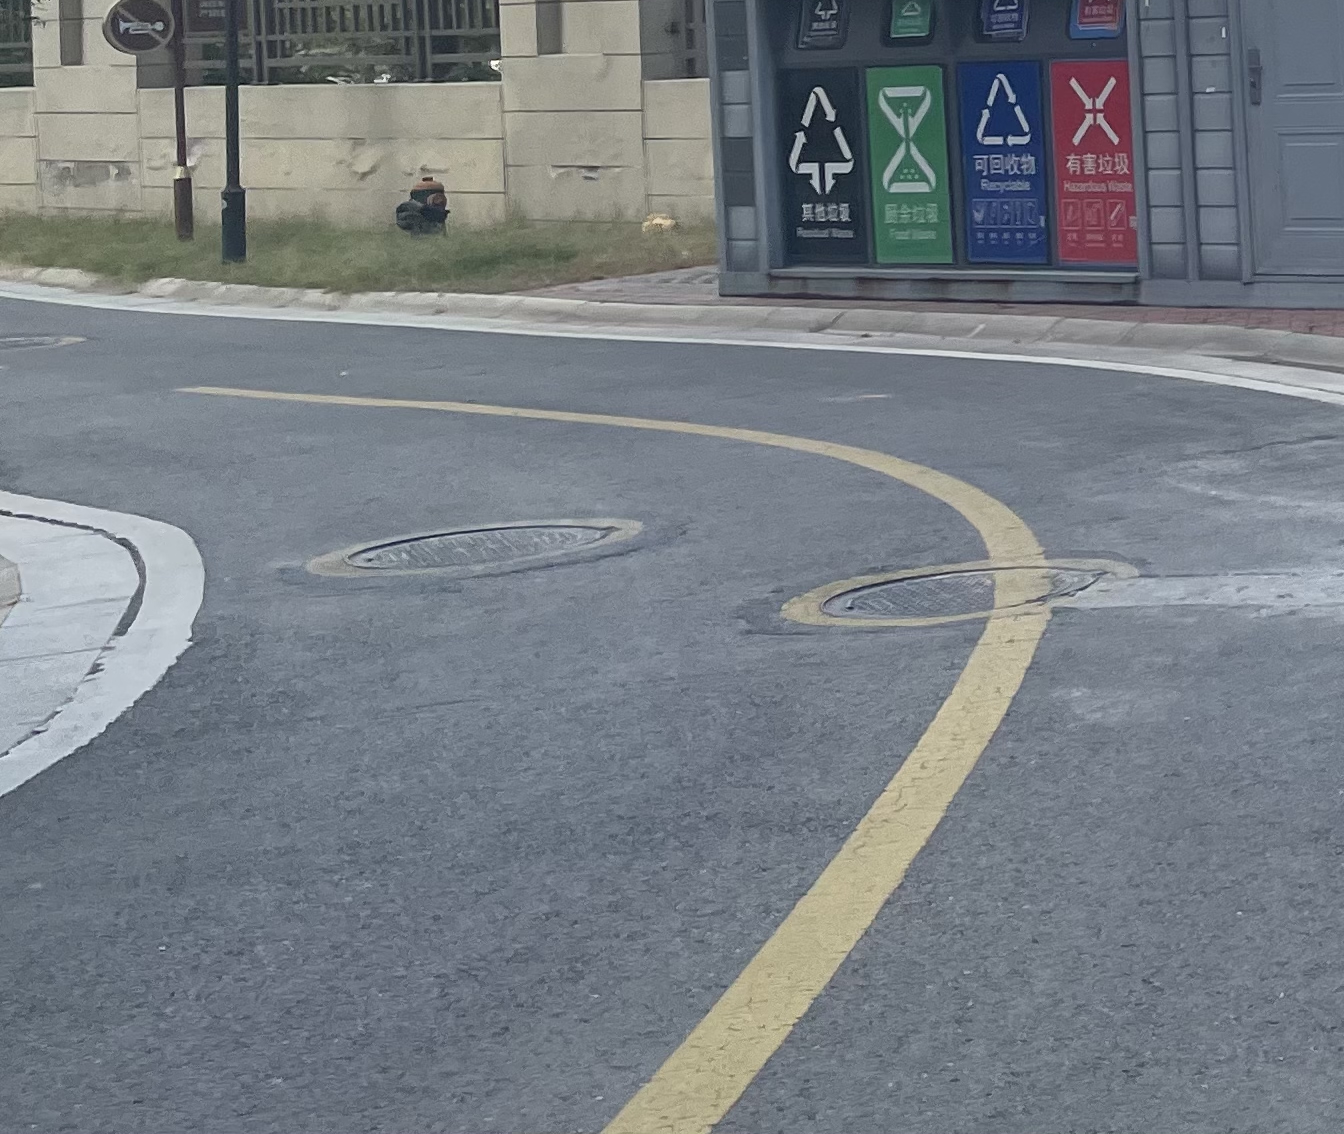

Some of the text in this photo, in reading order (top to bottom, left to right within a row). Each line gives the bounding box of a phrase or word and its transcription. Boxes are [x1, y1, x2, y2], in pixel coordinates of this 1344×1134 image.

[973, 153, 1036, 176] 可回收物
[1065, 153, 1130, 176] 有害垃圾
